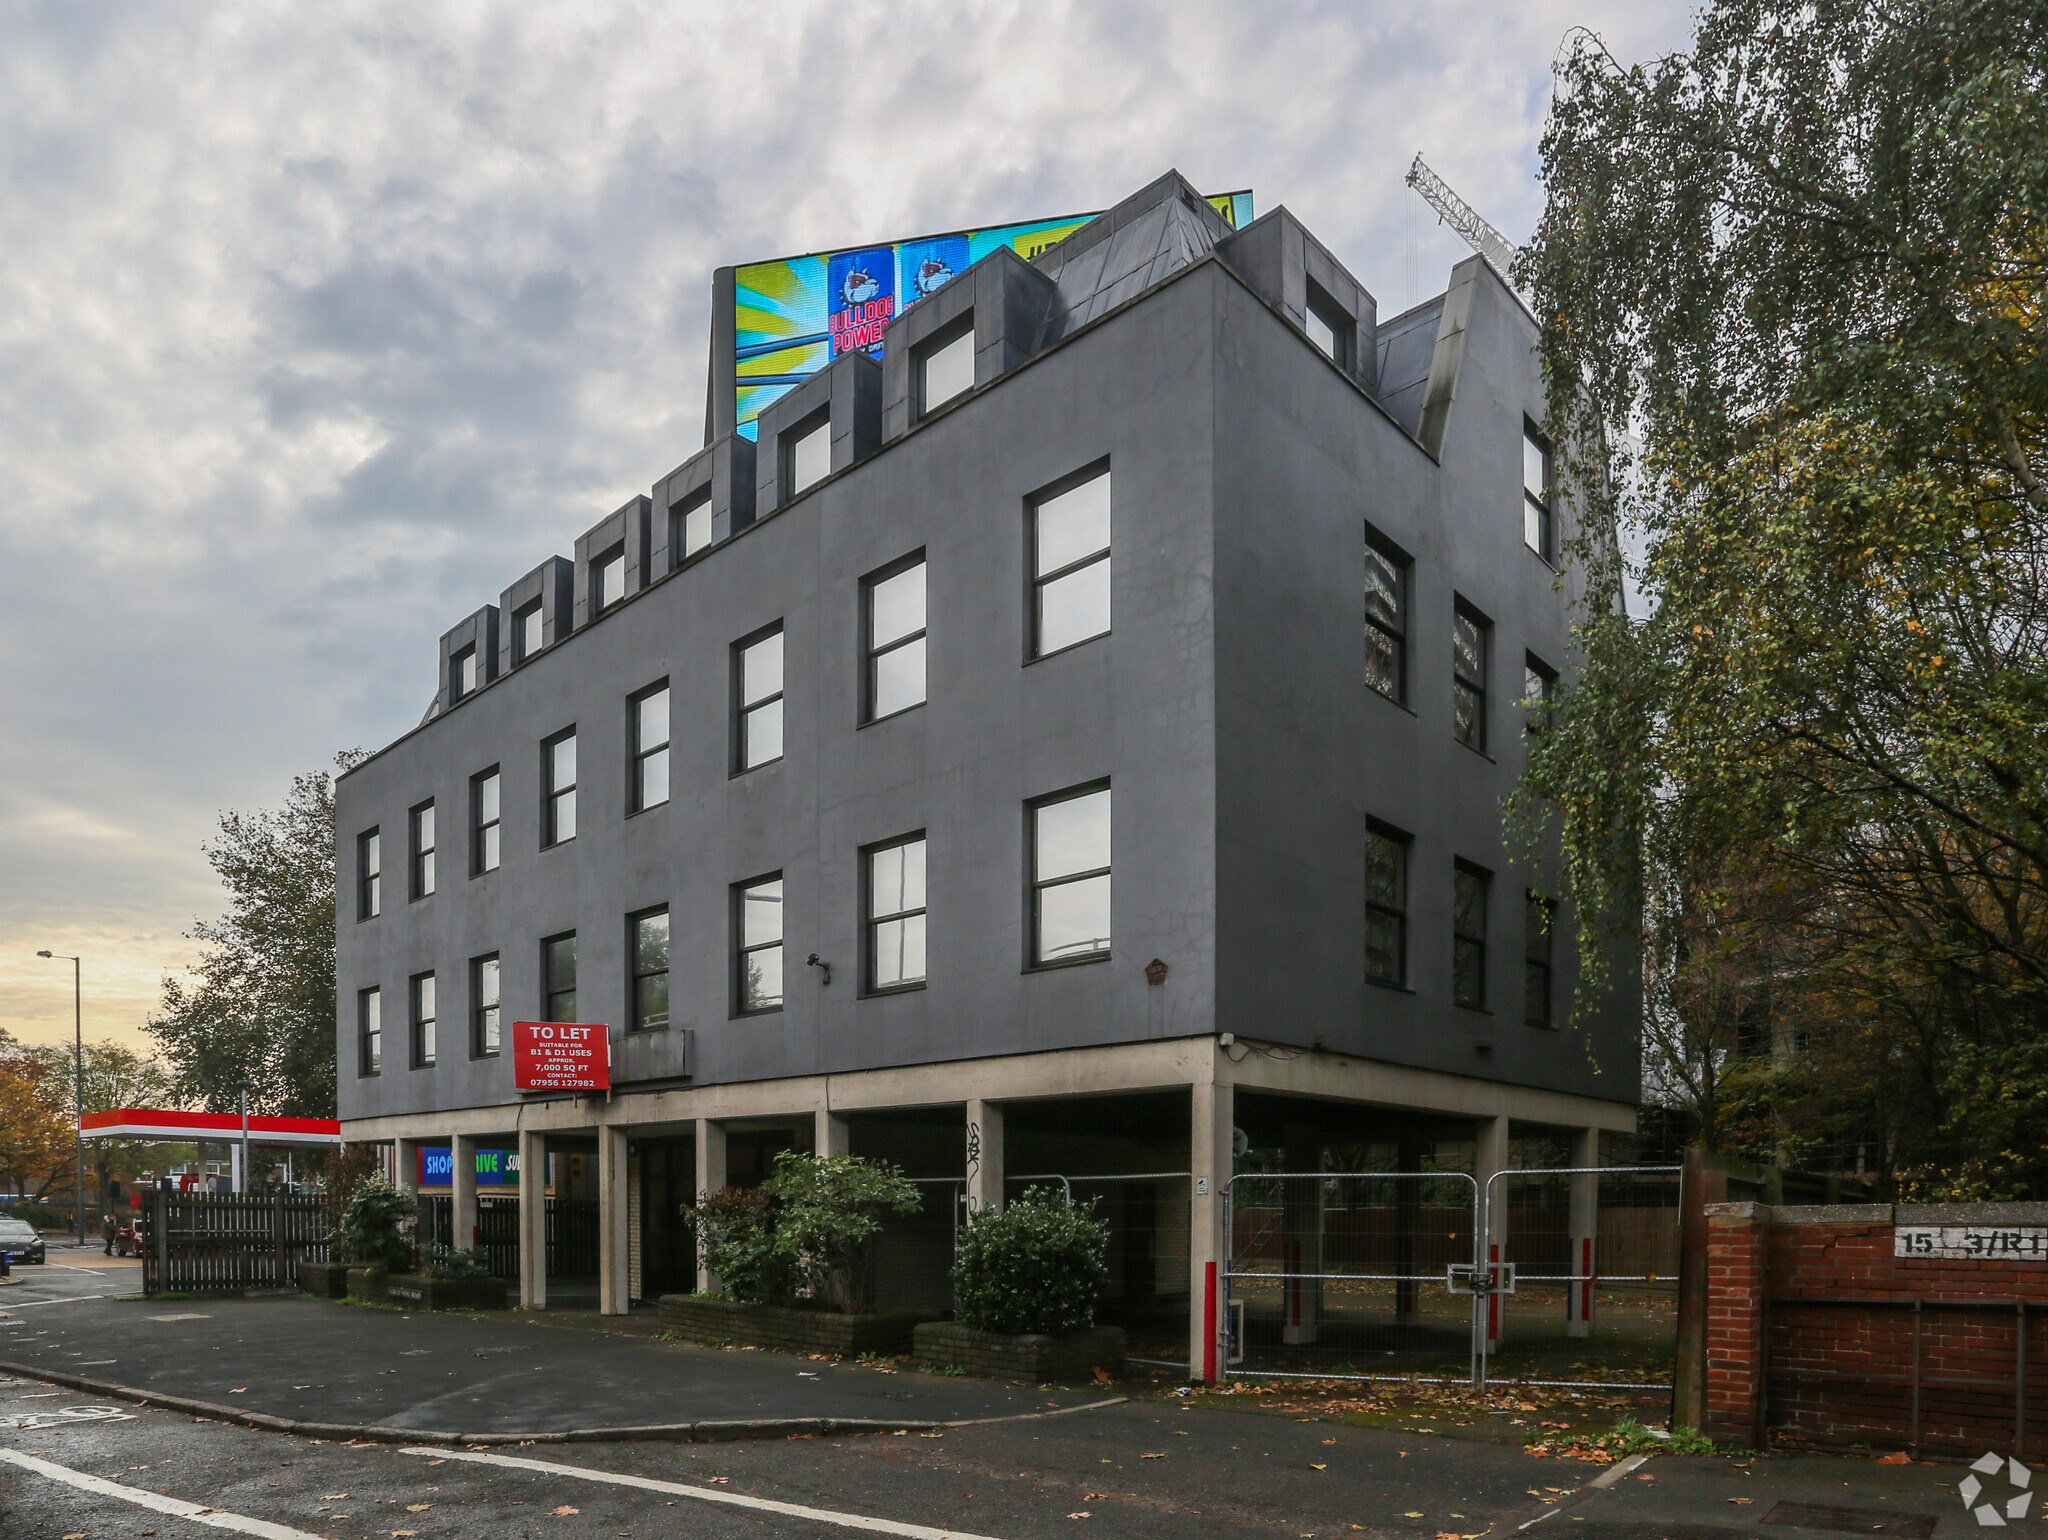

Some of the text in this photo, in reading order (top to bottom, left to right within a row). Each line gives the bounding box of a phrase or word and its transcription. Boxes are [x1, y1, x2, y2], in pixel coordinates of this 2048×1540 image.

[829, 295, 894, 336] BULLDOG
[530, 1026, 591, 1040] TO LET
[535, 1064, 560, 1072] 7,000
[563, 1064, 576, 1072] SQ
[427, 1153, 498, 1174] SHOP RIVE
[1903, 1232, 1933, 1253] 15
